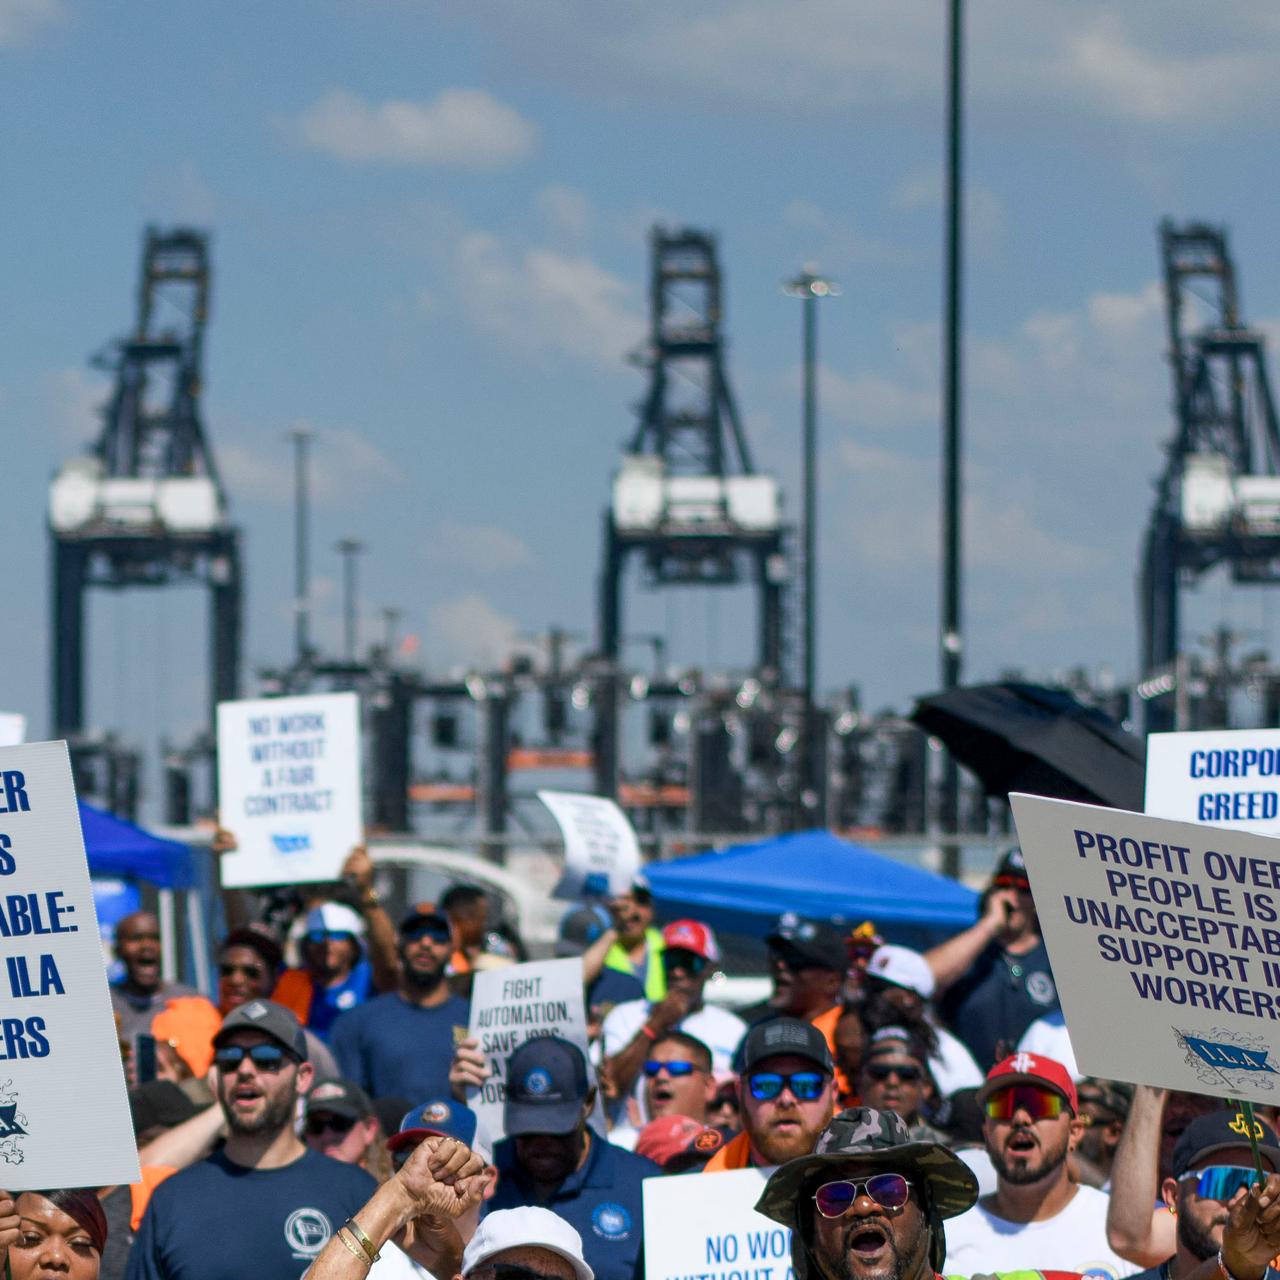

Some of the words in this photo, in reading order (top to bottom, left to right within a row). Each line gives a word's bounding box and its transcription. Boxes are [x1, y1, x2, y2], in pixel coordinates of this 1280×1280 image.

[248, 715, 270, 737] NO
[278, 711, 325, 735] WORK
[250, 737, 326, 761] WITHOUT
[261, 767, 273, 788] A
[278, 764, 316, 787] FAIR
[244, 789, 333, 816] CONTRACT
[1197, 791, 1278, 821] GREED
[1073, 829, 1190, 875] PROFIT
[1105, 868, 1236, 917] PEOPLE
[1243, 892, 1278, 922] IS
[1097, 934, 1250, 982] SUPPORT
[6, 953, 66, 999] ILA
[502, 976, 542, 1000] FIGHT
[477, 1001, 573, 1028] AUTOMATION,
[482, 1031, 519, 1054] SAVE
[706, 1233, 738, 1264] NO
